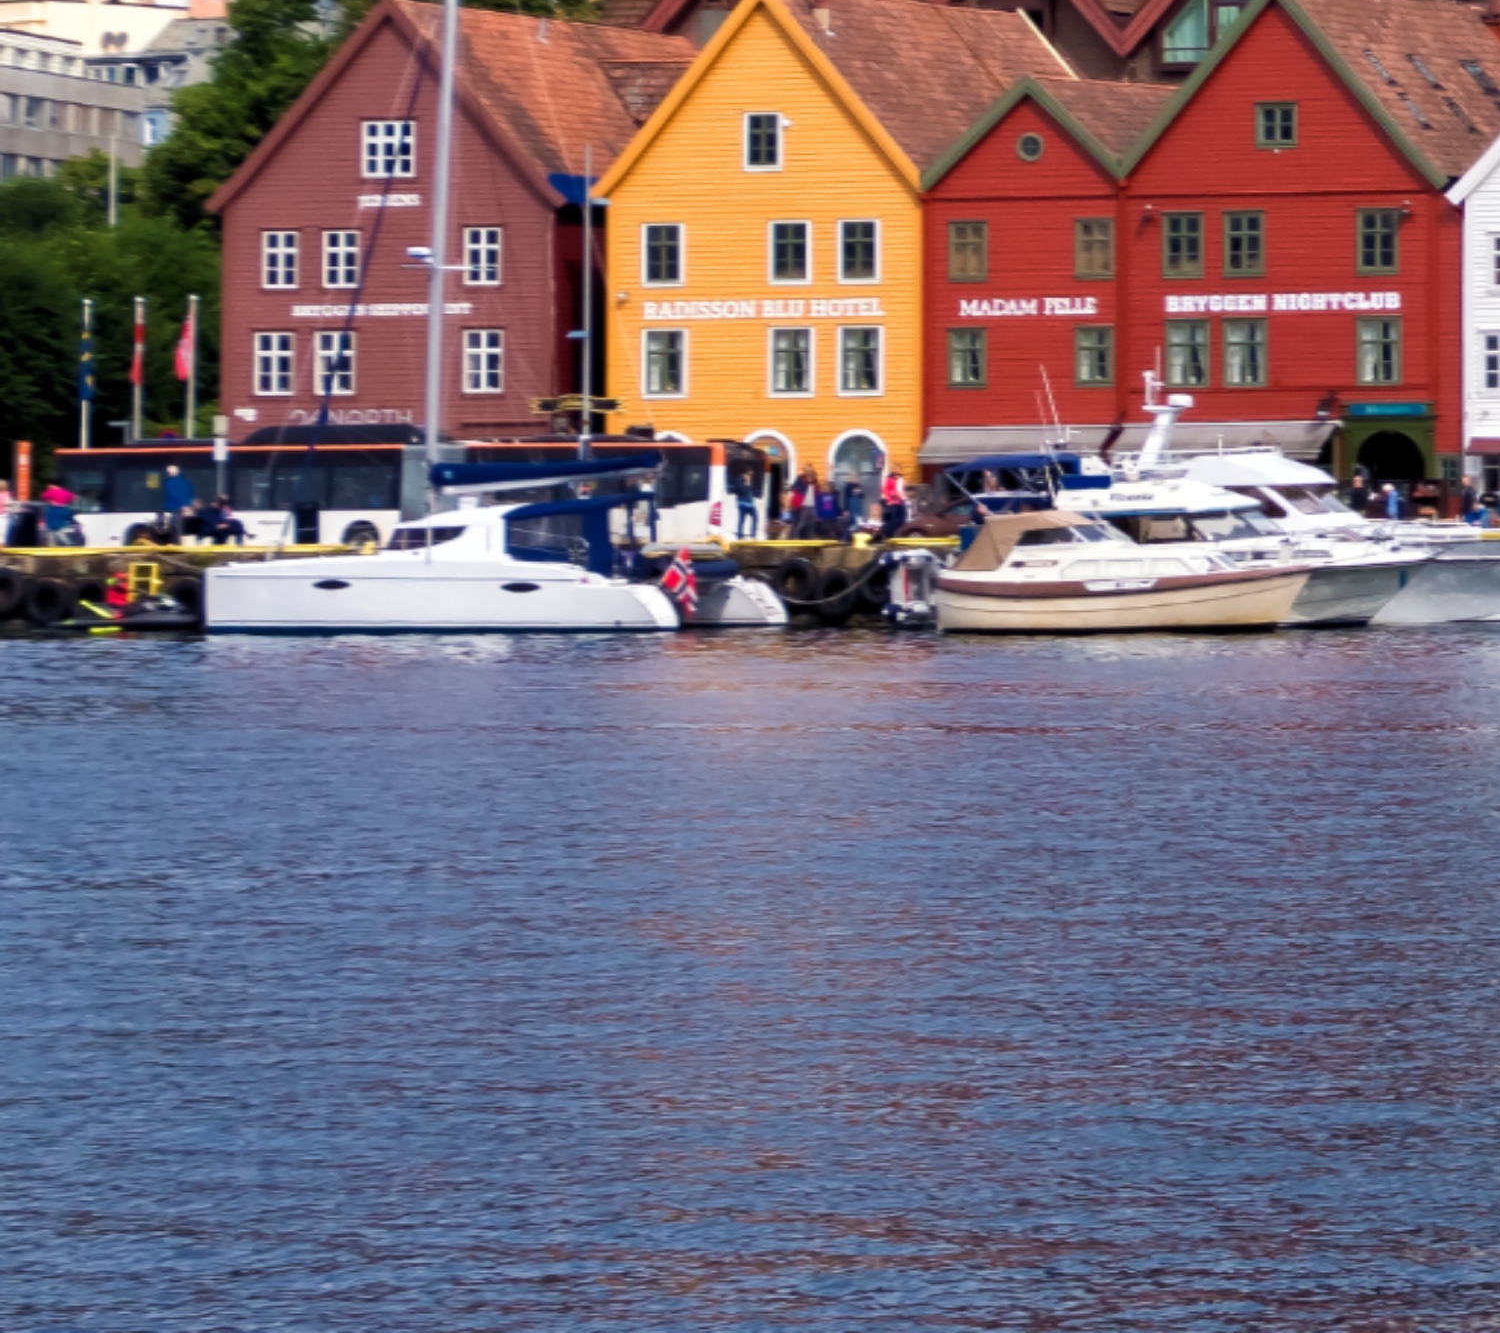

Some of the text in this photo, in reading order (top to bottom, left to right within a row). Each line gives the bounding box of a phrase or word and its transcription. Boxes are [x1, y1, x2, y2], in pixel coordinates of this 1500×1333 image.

[643, 297, 886, 320] RADISSON BLU HOTEL
[959, 296, 1098, 317] MADAM FELLE
[1165, 292, 1402, 313] BRYGGEN NIGHTCLUB
